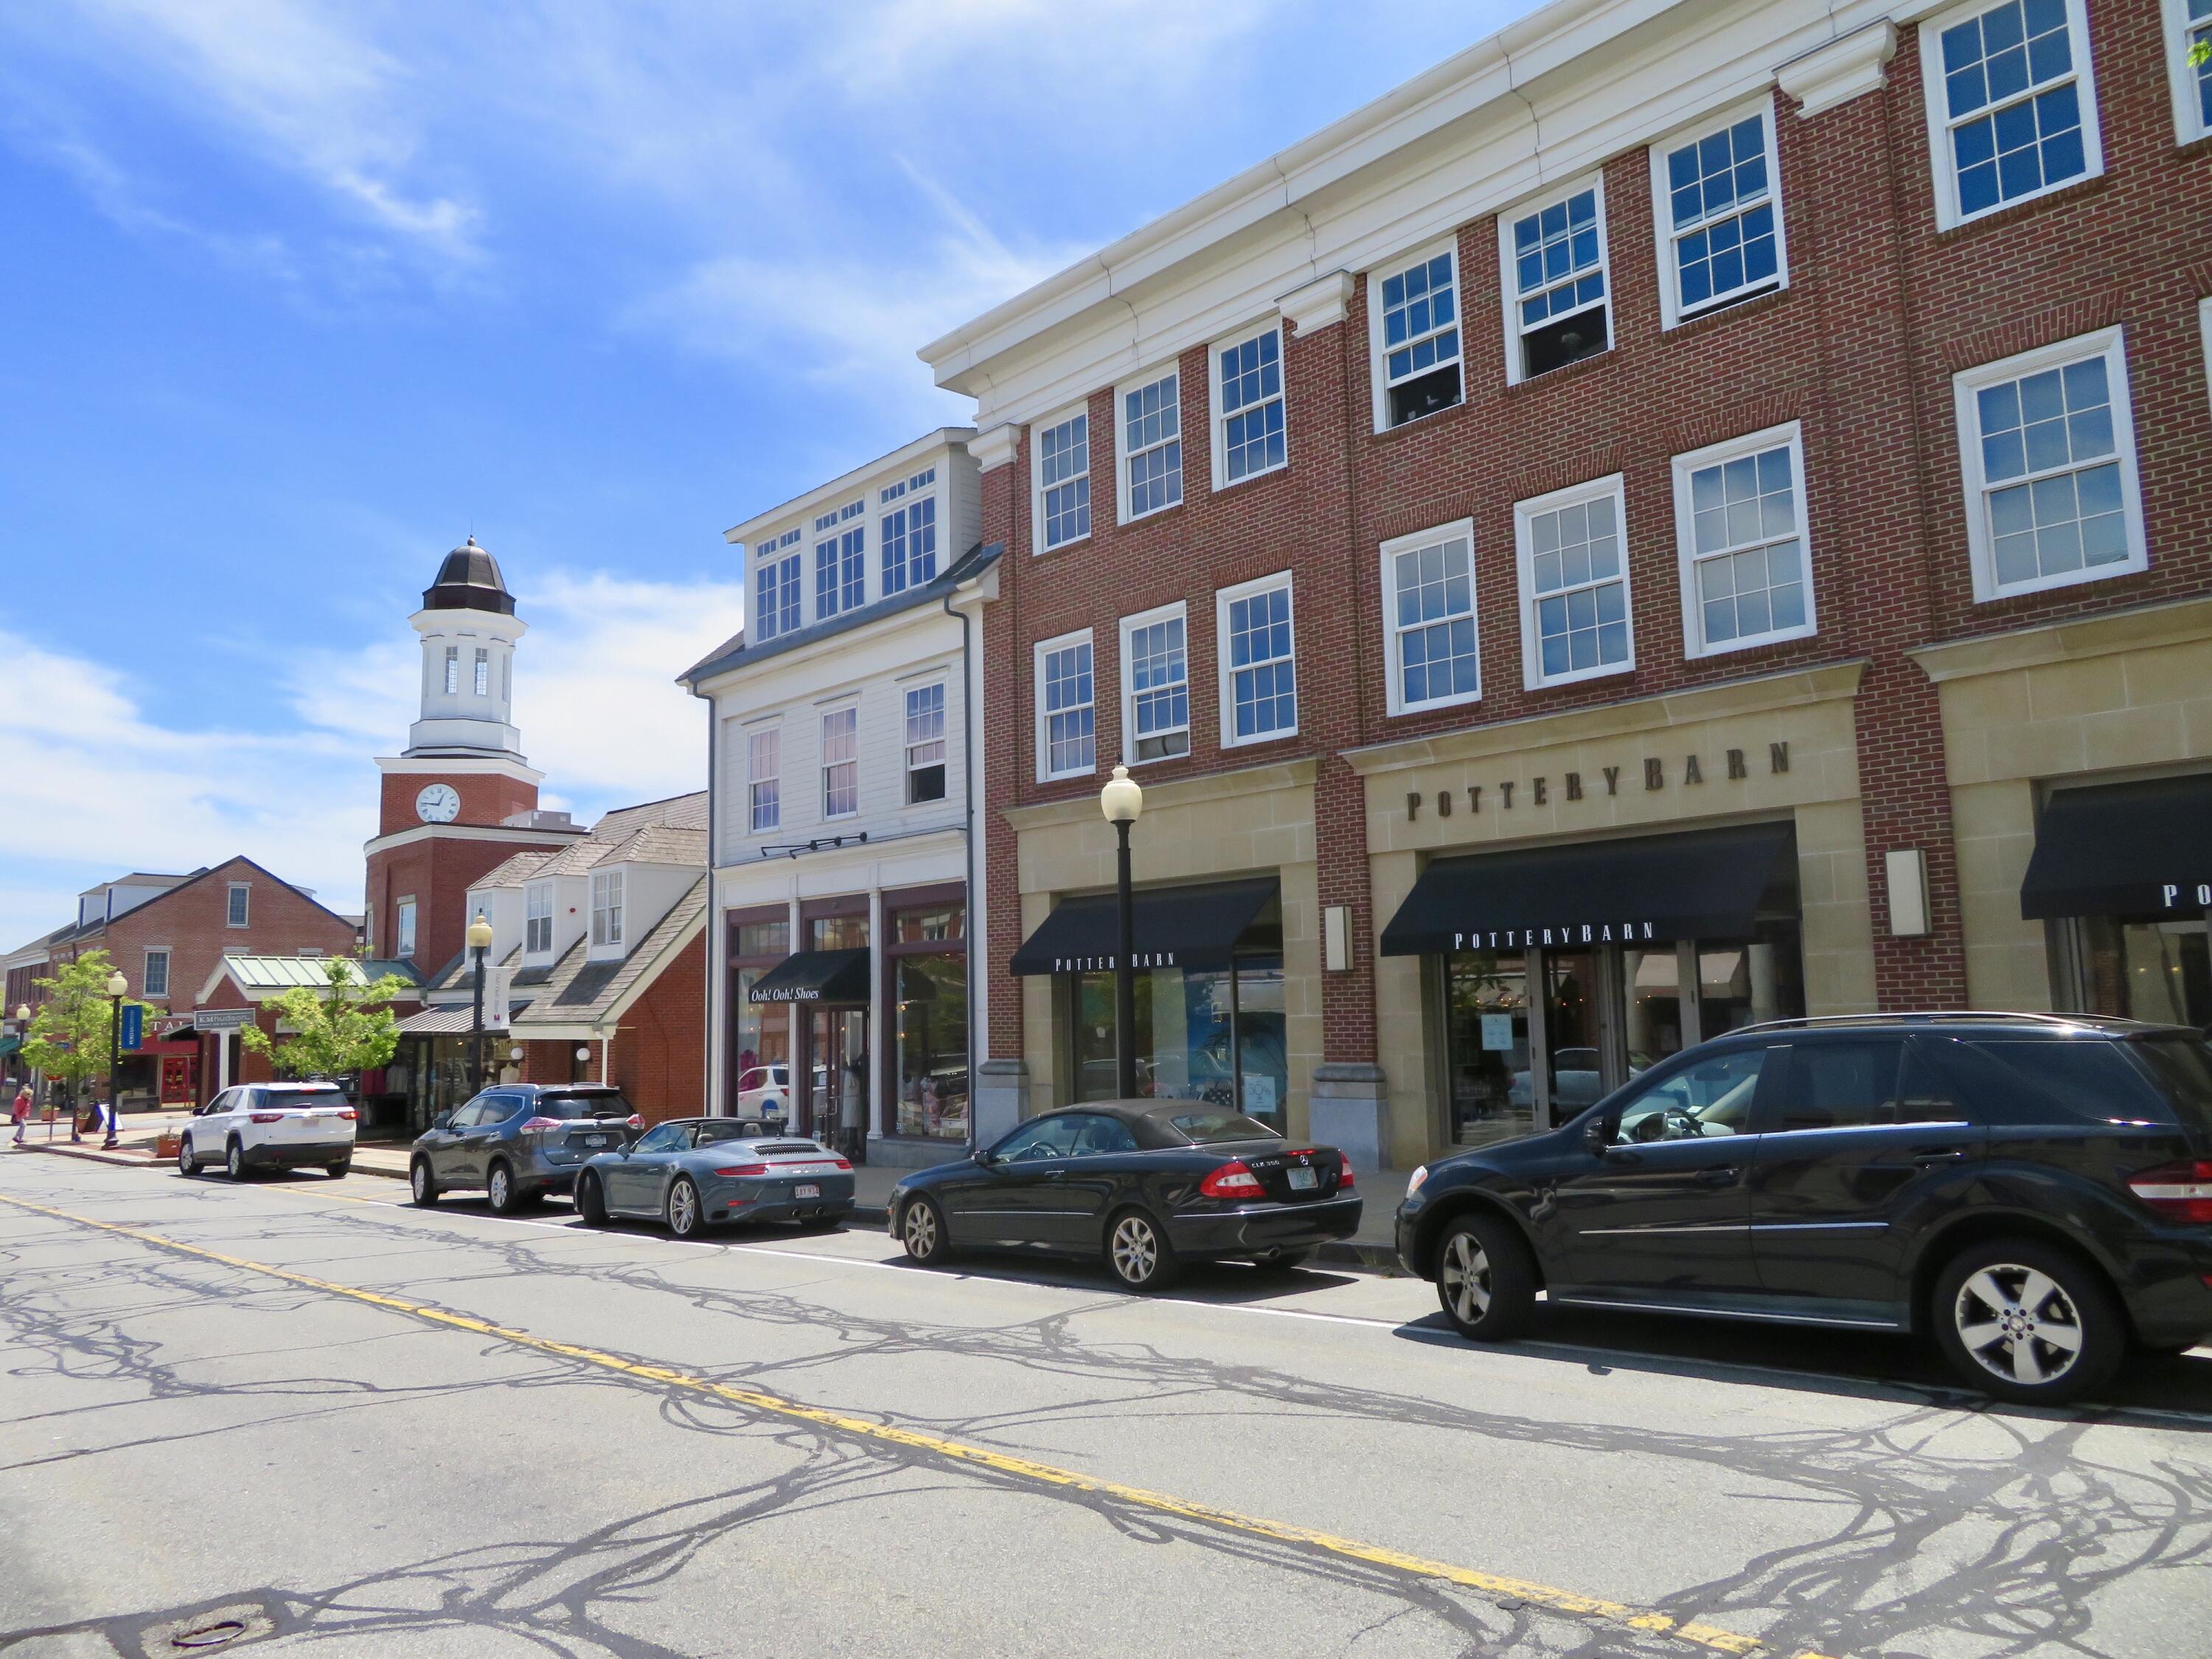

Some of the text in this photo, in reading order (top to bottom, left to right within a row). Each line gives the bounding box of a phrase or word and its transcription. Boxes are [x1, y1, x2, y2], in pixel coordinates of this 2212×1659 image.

[1406, 742, 1789, 821] POTTERY BARN
[1455, 922, 1652, 950] POTTERY BARN
[1056, 952, 1174, 972] POTTER BARN
[751, 987, 819, 1002] Ooh! Ooh! Shoes
